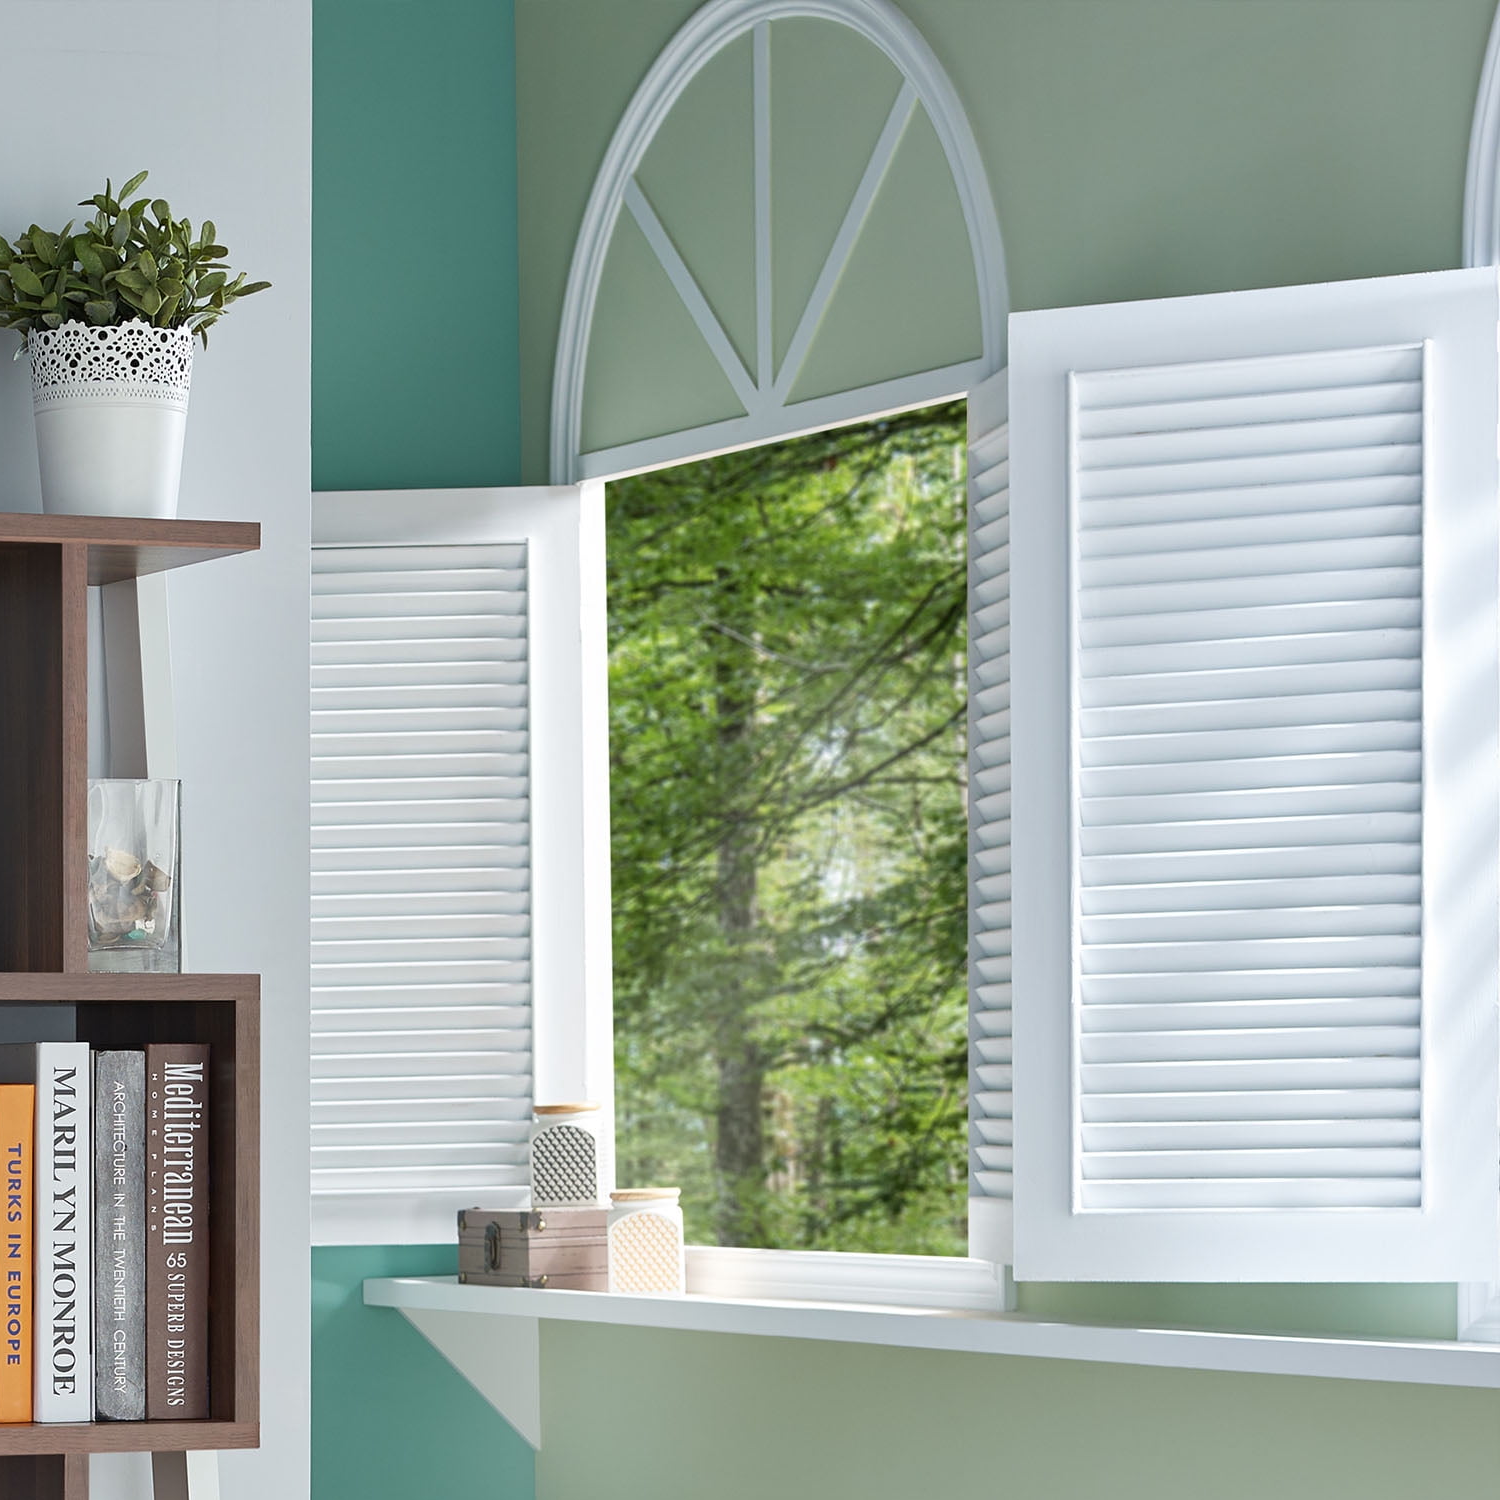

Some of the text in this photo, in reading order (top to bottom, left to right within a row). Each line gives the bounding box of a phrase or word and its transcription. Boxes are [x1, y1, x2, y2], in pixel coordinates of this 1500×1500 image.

[7, 1143, 21, 1364] TURKS IN EUROPE
[53, 1067, 77, 1396] MARILYN MONROE
[113, 1081, 126, 1394] ARCHITECTURE IN THE TWENTIETH CENTURY
[163, 1062, 203, 1406] Mediterranean 65 SUPERB DESIGNS
